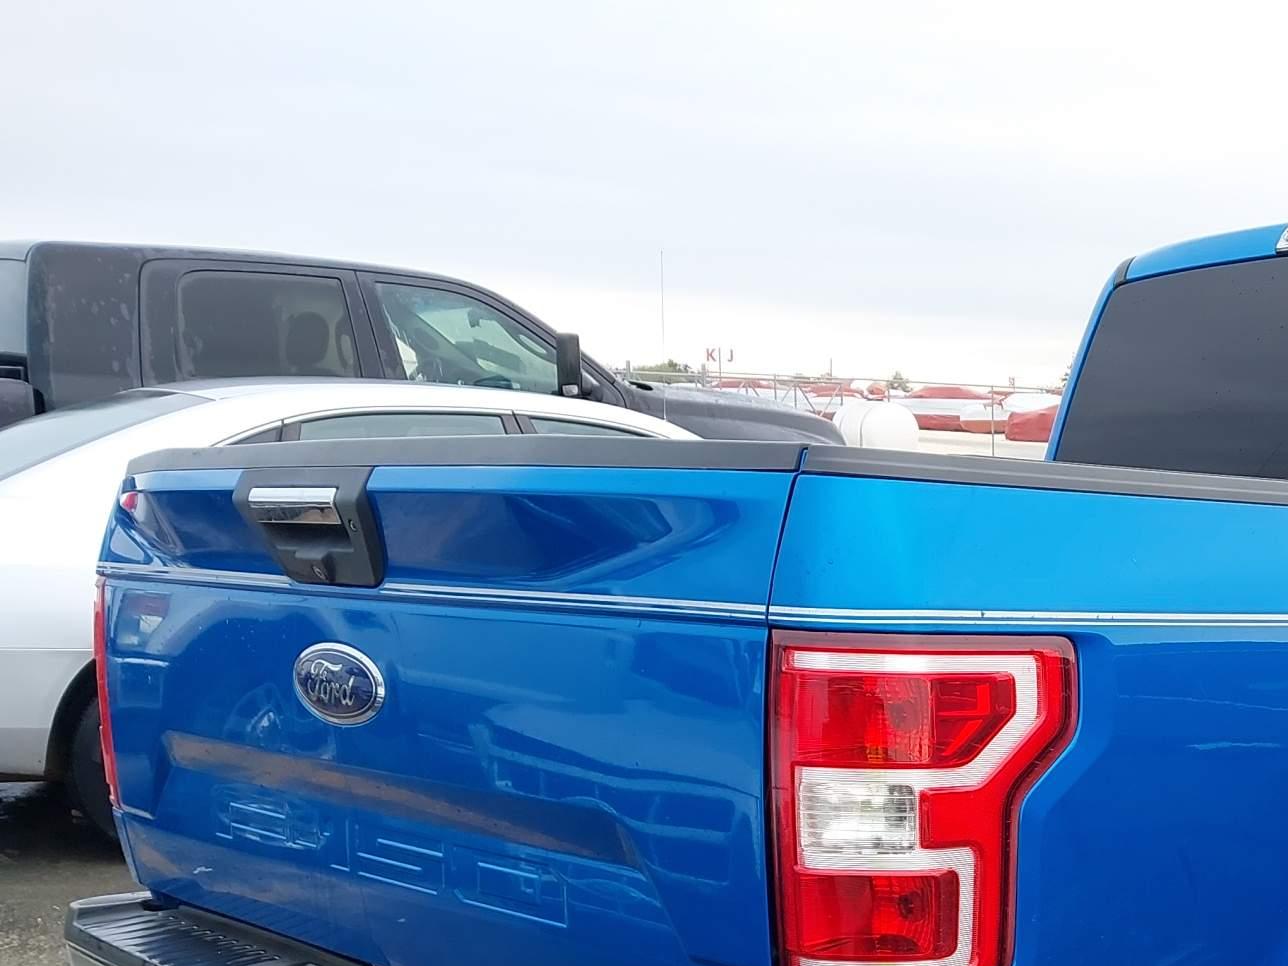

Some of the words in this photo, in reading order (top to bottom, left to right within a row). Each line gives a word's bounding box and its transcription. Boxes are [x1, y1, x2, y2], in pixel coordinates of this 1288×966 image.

[706, 348, 717, 362] K
[727, 349, 734, 362] J
[306, 659, 356, 706] Ford
